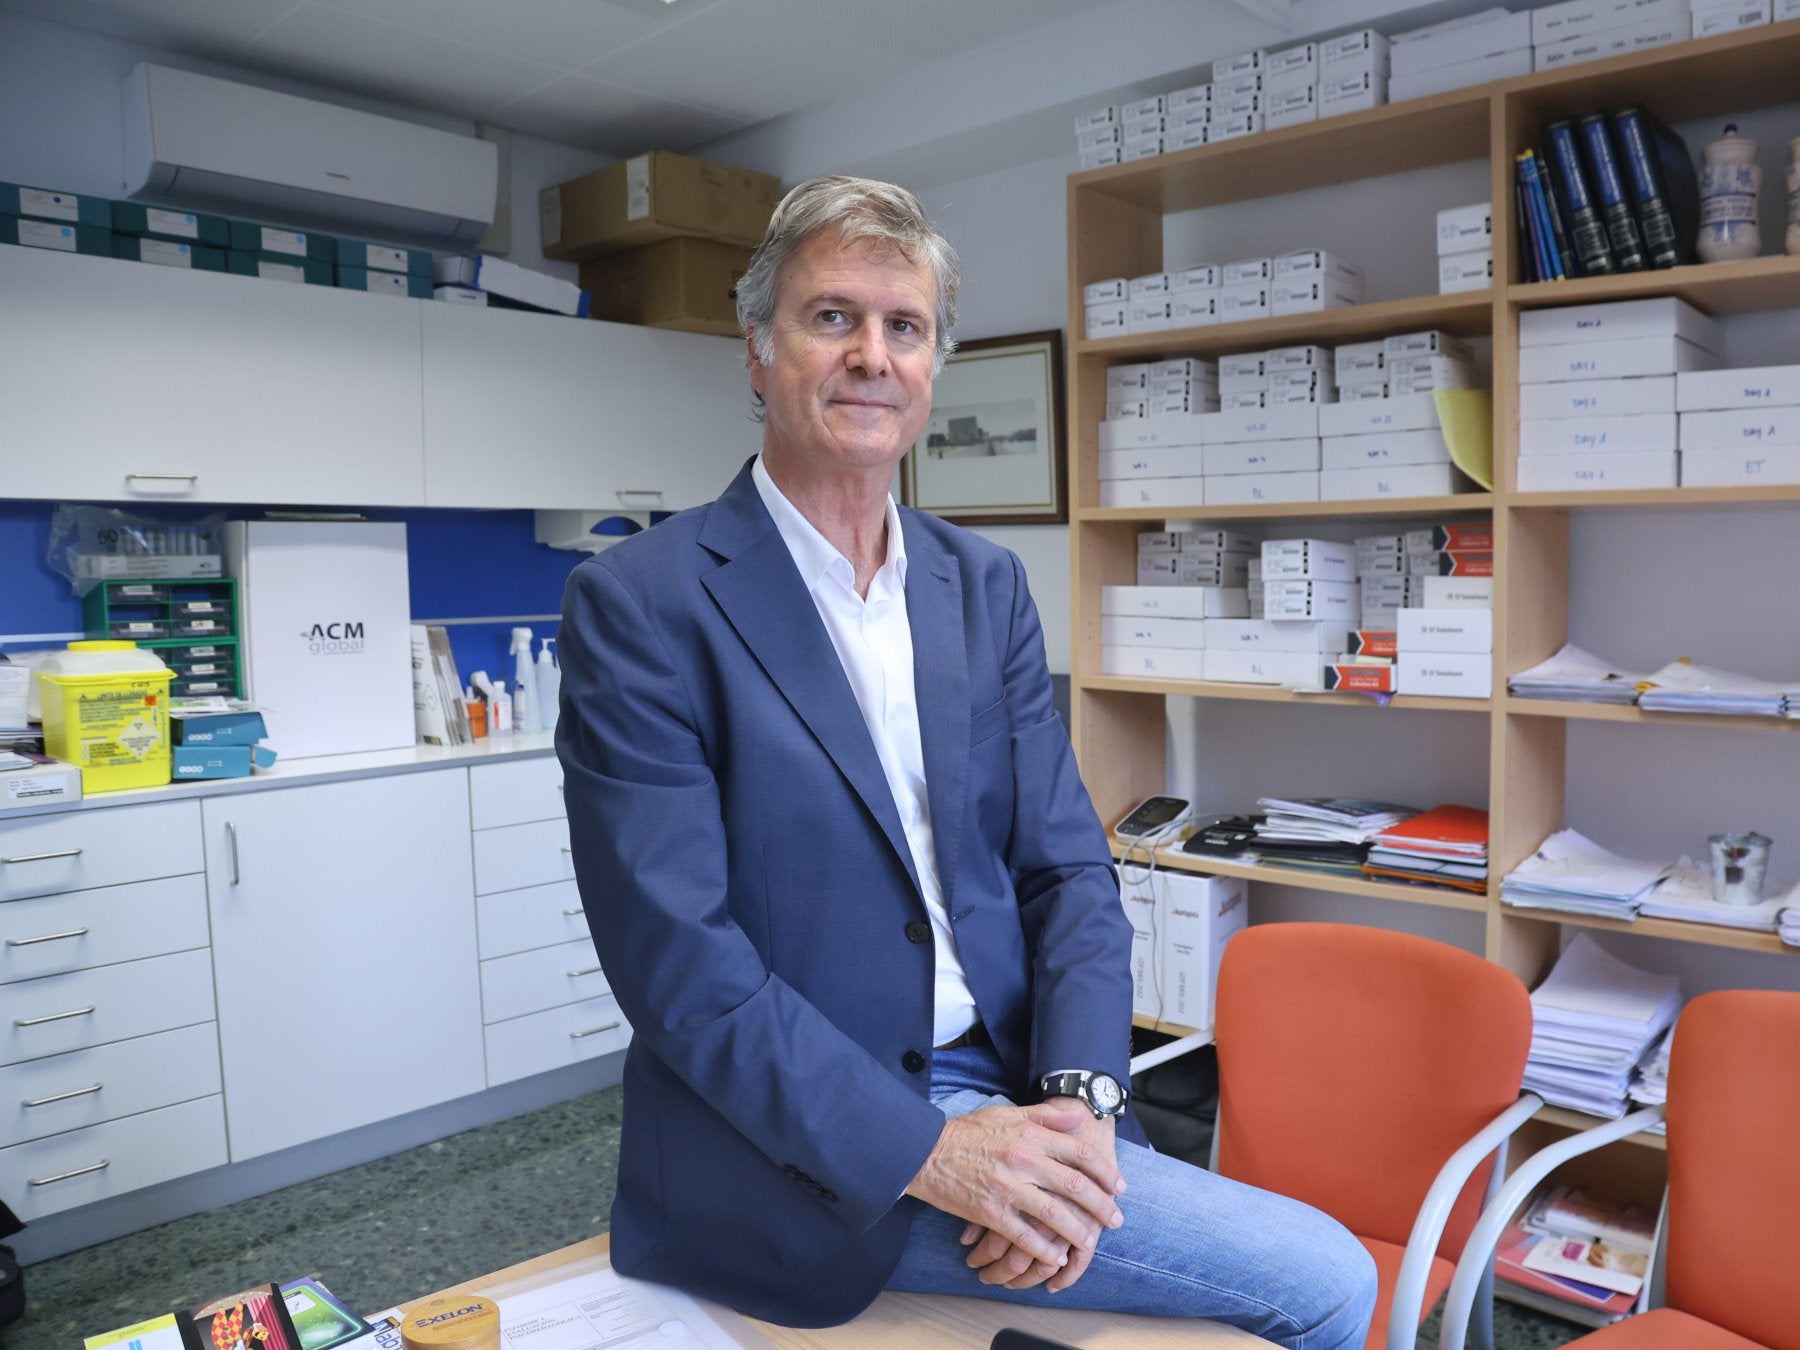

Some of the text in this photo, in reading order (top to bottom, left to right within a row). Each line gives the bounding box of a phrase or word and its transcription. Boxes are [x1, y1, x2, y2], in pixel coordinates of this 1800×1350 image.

[311, 622, 364, 640] ACM
[308, 638, 365, 656] global
[415, 1303, 484, 1328] EXELON
